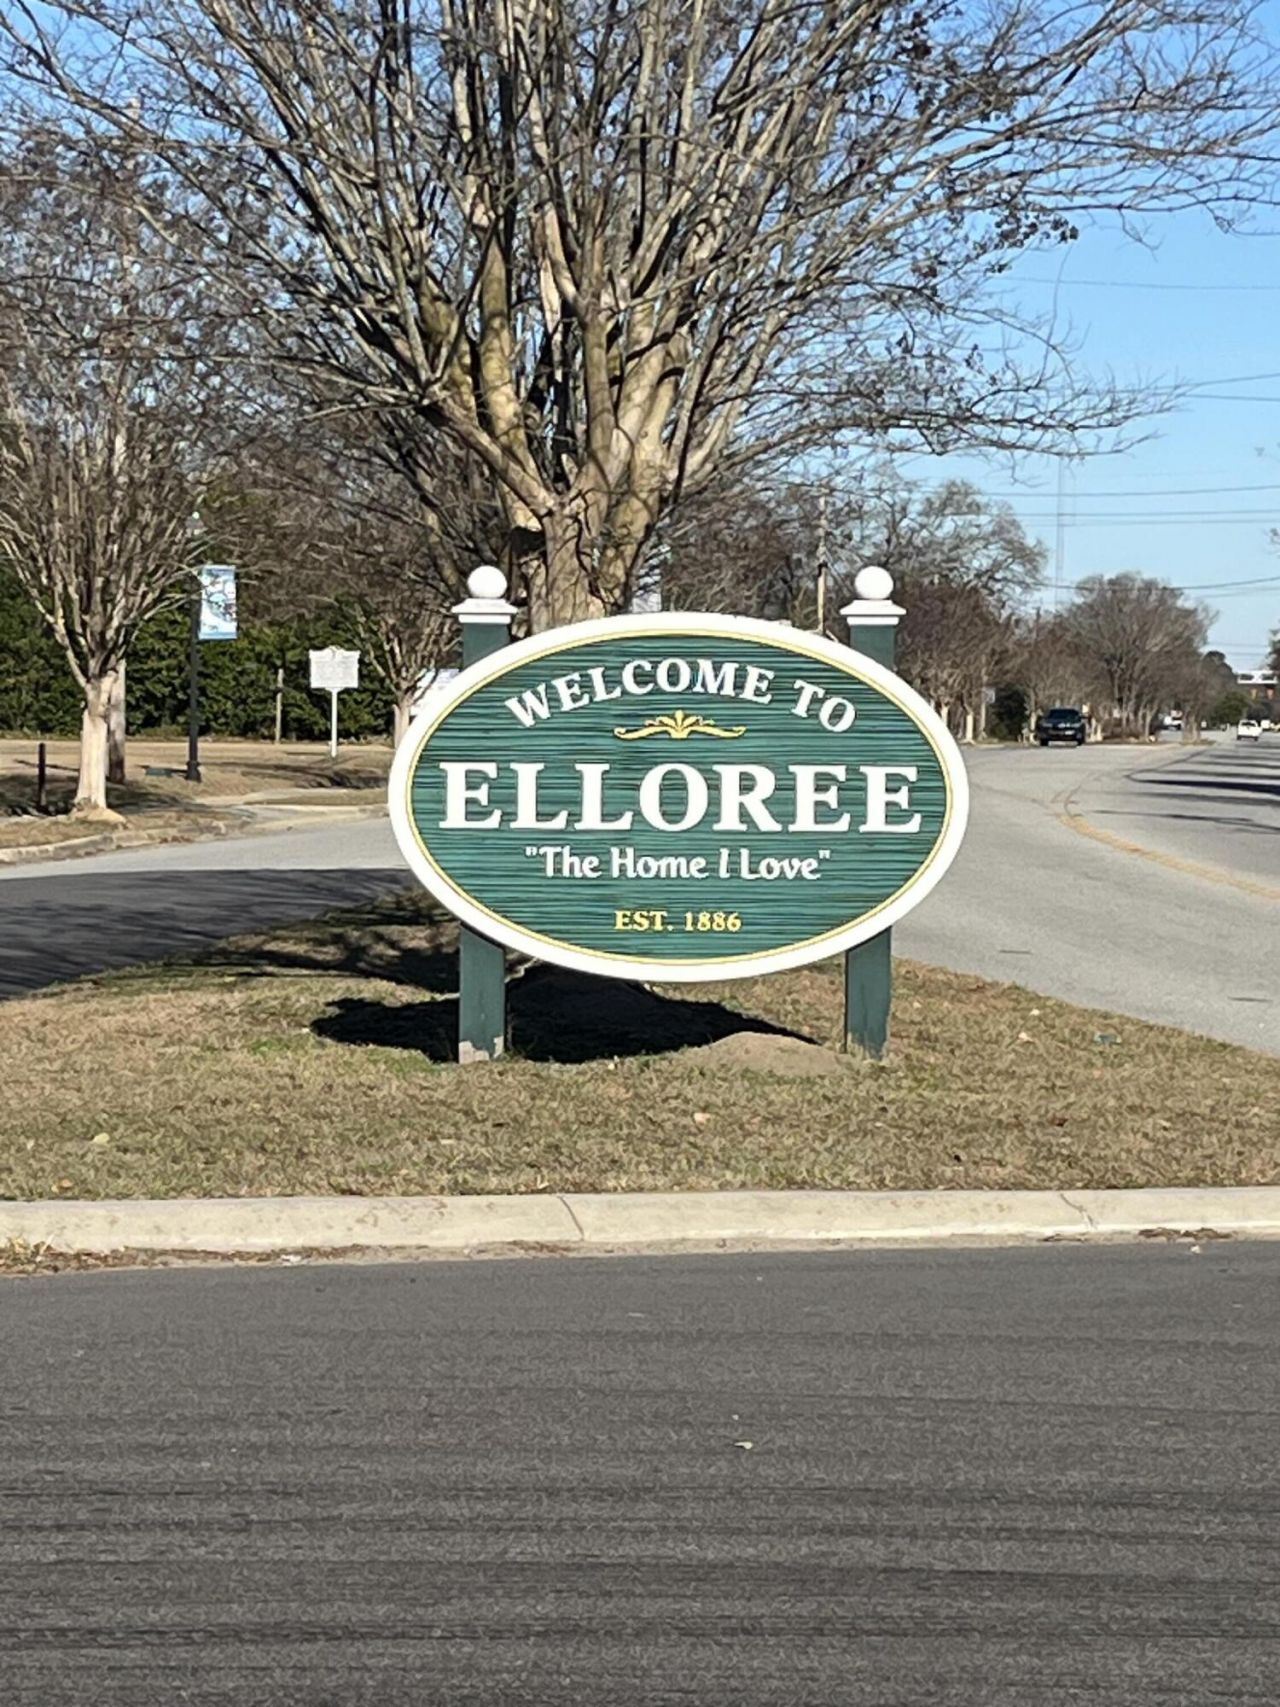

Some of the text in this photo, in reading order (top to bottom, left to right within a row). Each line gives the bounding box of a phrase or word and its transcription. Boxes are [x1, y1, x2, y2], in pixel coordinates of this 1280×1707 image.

[505, 657, 857, 733] WELCOME TO
[439, 762, 923, 833] ELLOREE
[526, 846, 831, 880] "The Home I Love"
[614, 910, 742, 933] EST. 1886
